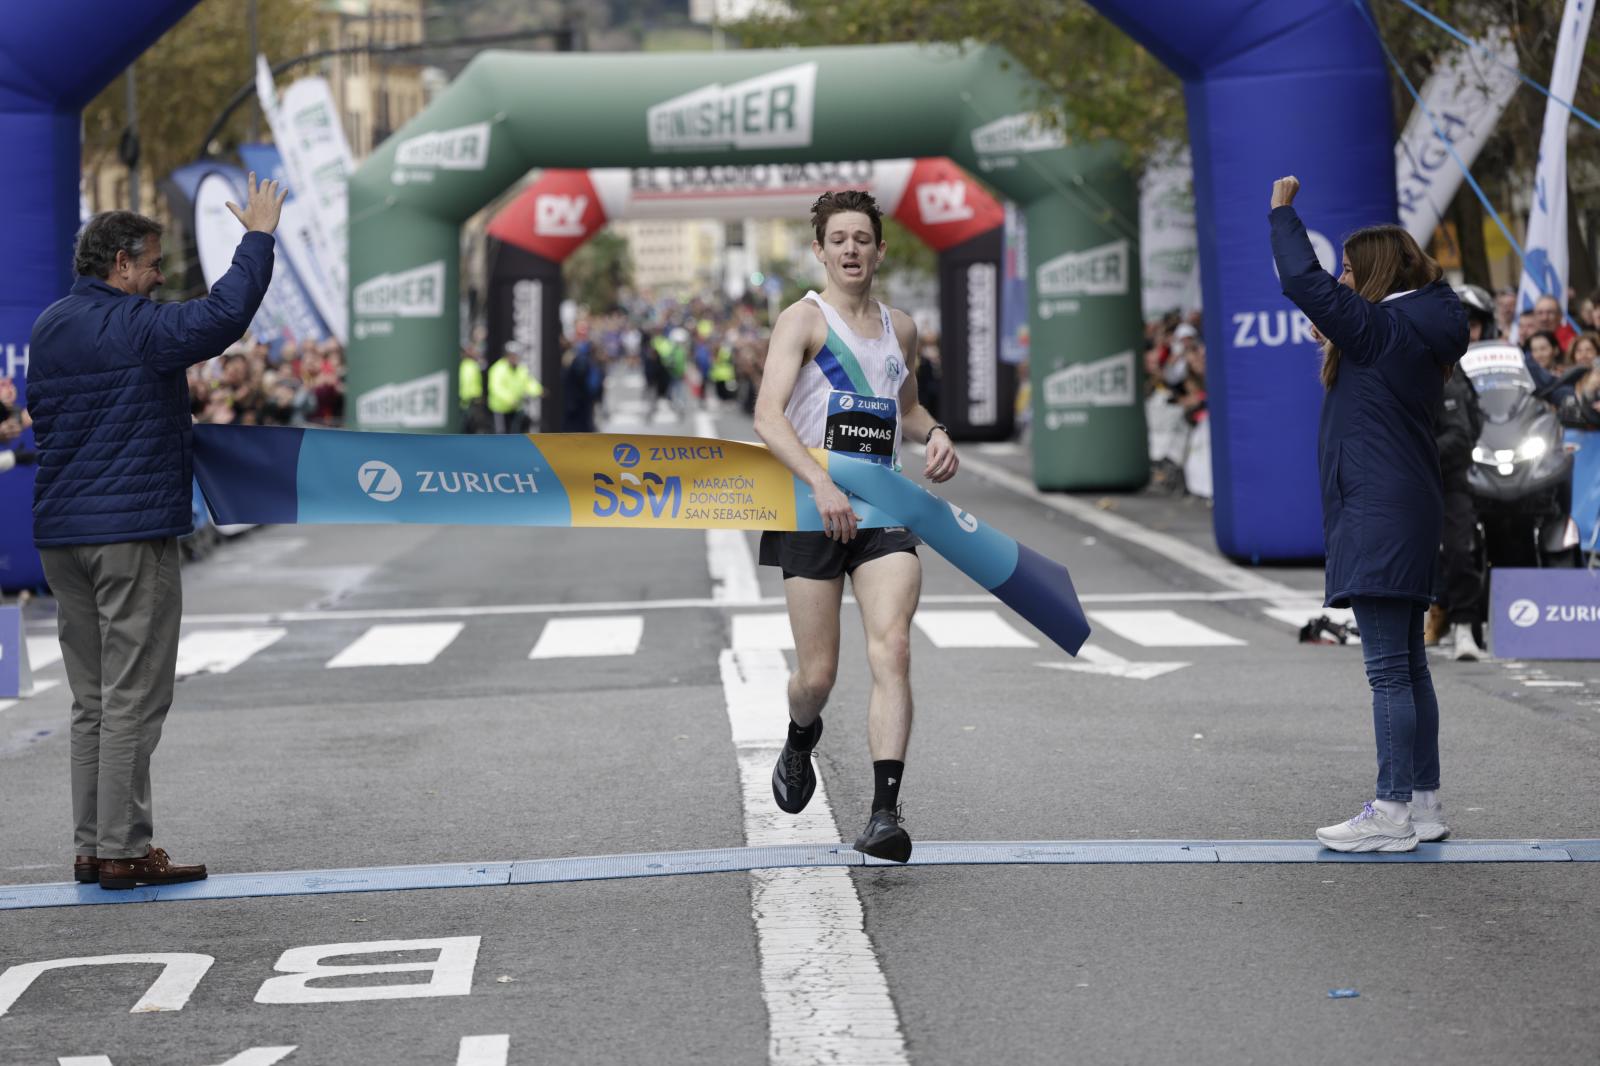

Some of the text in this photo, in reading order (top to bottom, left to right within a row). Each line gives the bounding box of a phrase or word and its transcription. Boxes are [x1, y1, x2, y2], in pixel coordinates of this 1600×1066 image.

[655, 83, 797, 138] FINISHER
[1399, 111, 1466, 217] RICH
[916, 180, 970, 224] DV
[534, 194, 588, 232] DV
[1232, 310, 1317, 348] ZUR
[857, 400, 889, 411] ZURICH
[839, 424, 892, 440] THOMAS
[648, 447, 724, 461] ZURICH
[859, 443, 872, 452] 26
[415, 471, 539, 493] ZURICH
[693, 475, 755, 489] MARATÓN
[593, 471, 682, 518] SSM
[689, 493, 754, 505] DONOSTIA
[685, 506, 777, 521] SAN SEBASTIÁN
[1545, 605, 1600, 622] ZURI
[0, 935, 482, 1017] BU
